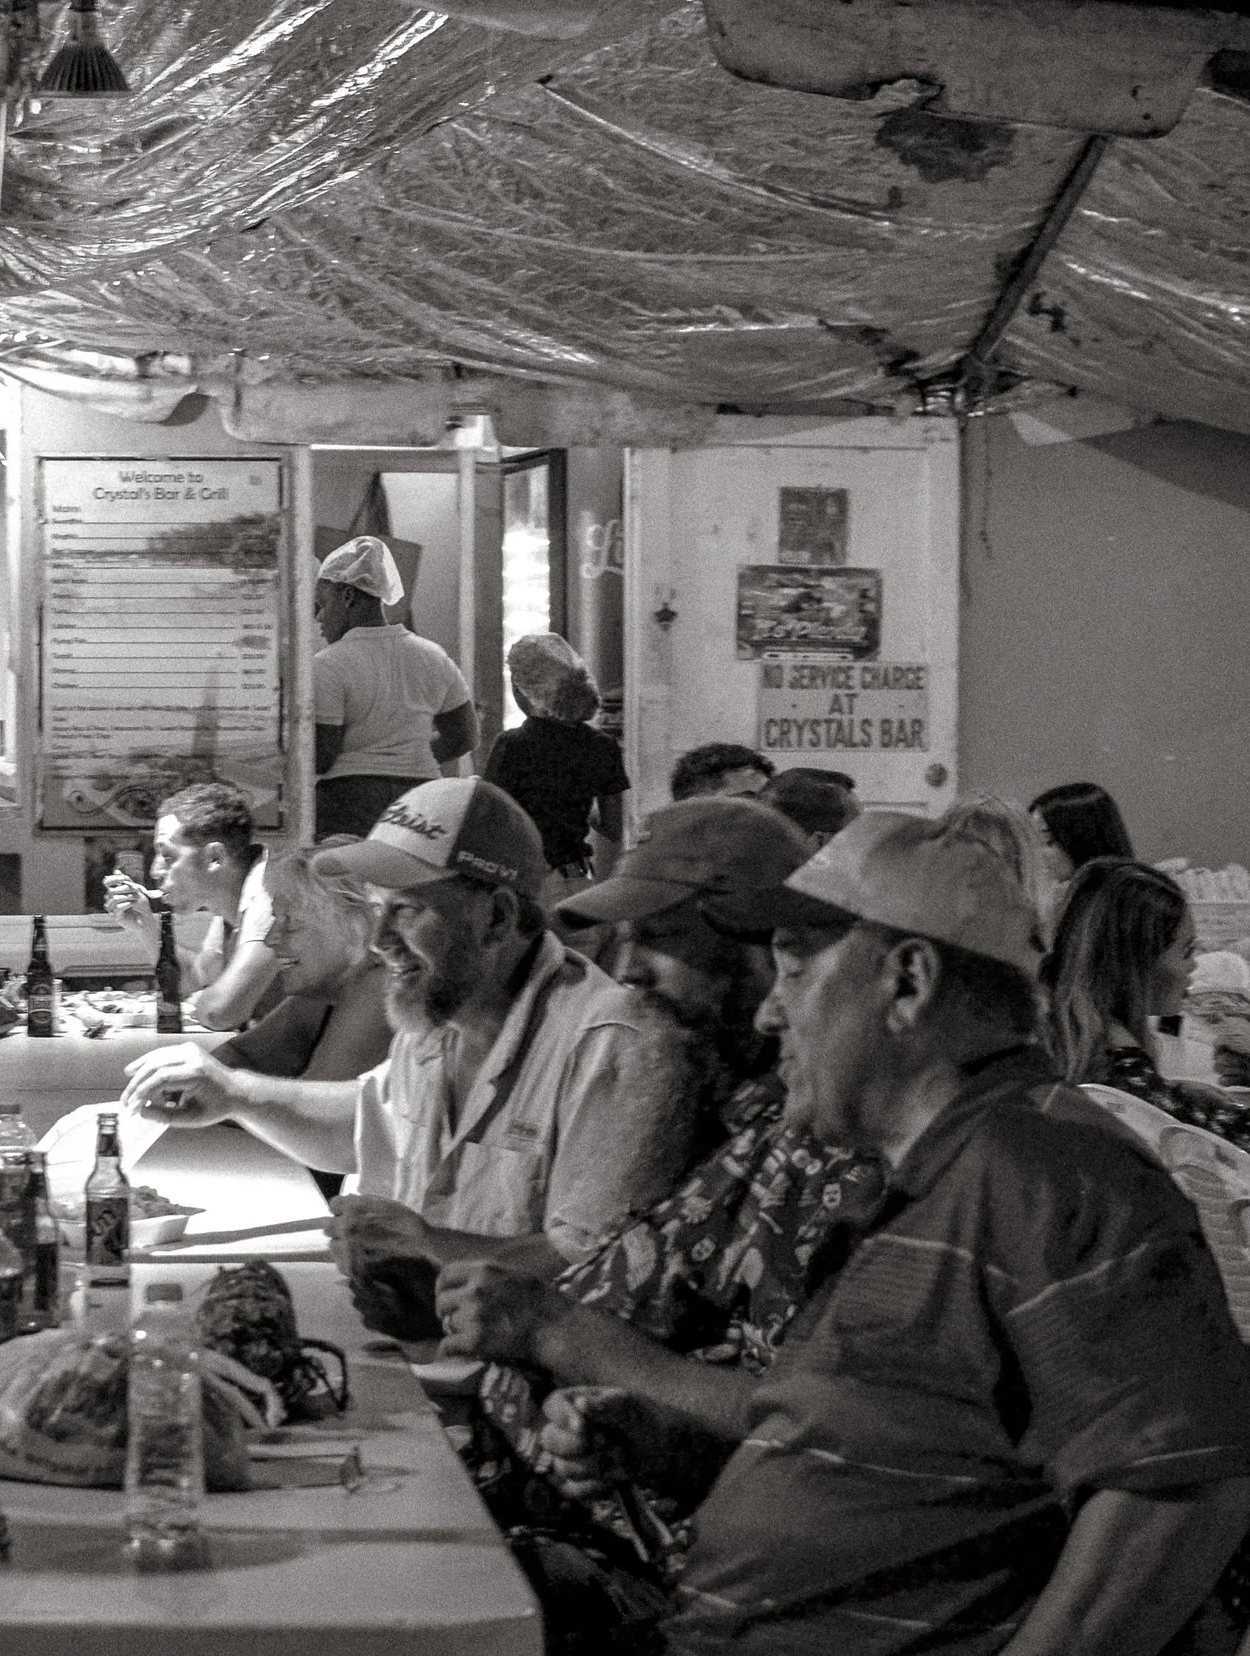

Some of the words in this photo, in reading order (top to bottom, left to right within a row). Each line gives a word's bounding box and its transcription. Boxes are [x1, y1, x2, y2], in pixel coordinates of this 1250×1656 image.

[119, 470, 185, 484] Welcome
[189, 471, 204, 484] to
[92, 486, 152, 502] Crystal's
[155, 487, 180, 501] Bar
[184, 487, 198, 501] &
[202, 486, 229, 501] Grill
[762, 664, 783, 690] NO
[789, 664, 855, 690] SERVICE
[860, 665, 924, 690] CHARGE
[828, 692, 860, 715] AT
[765, 717, 873, 748] CRYSTALS
[879, 717, 925, 748] BAR
